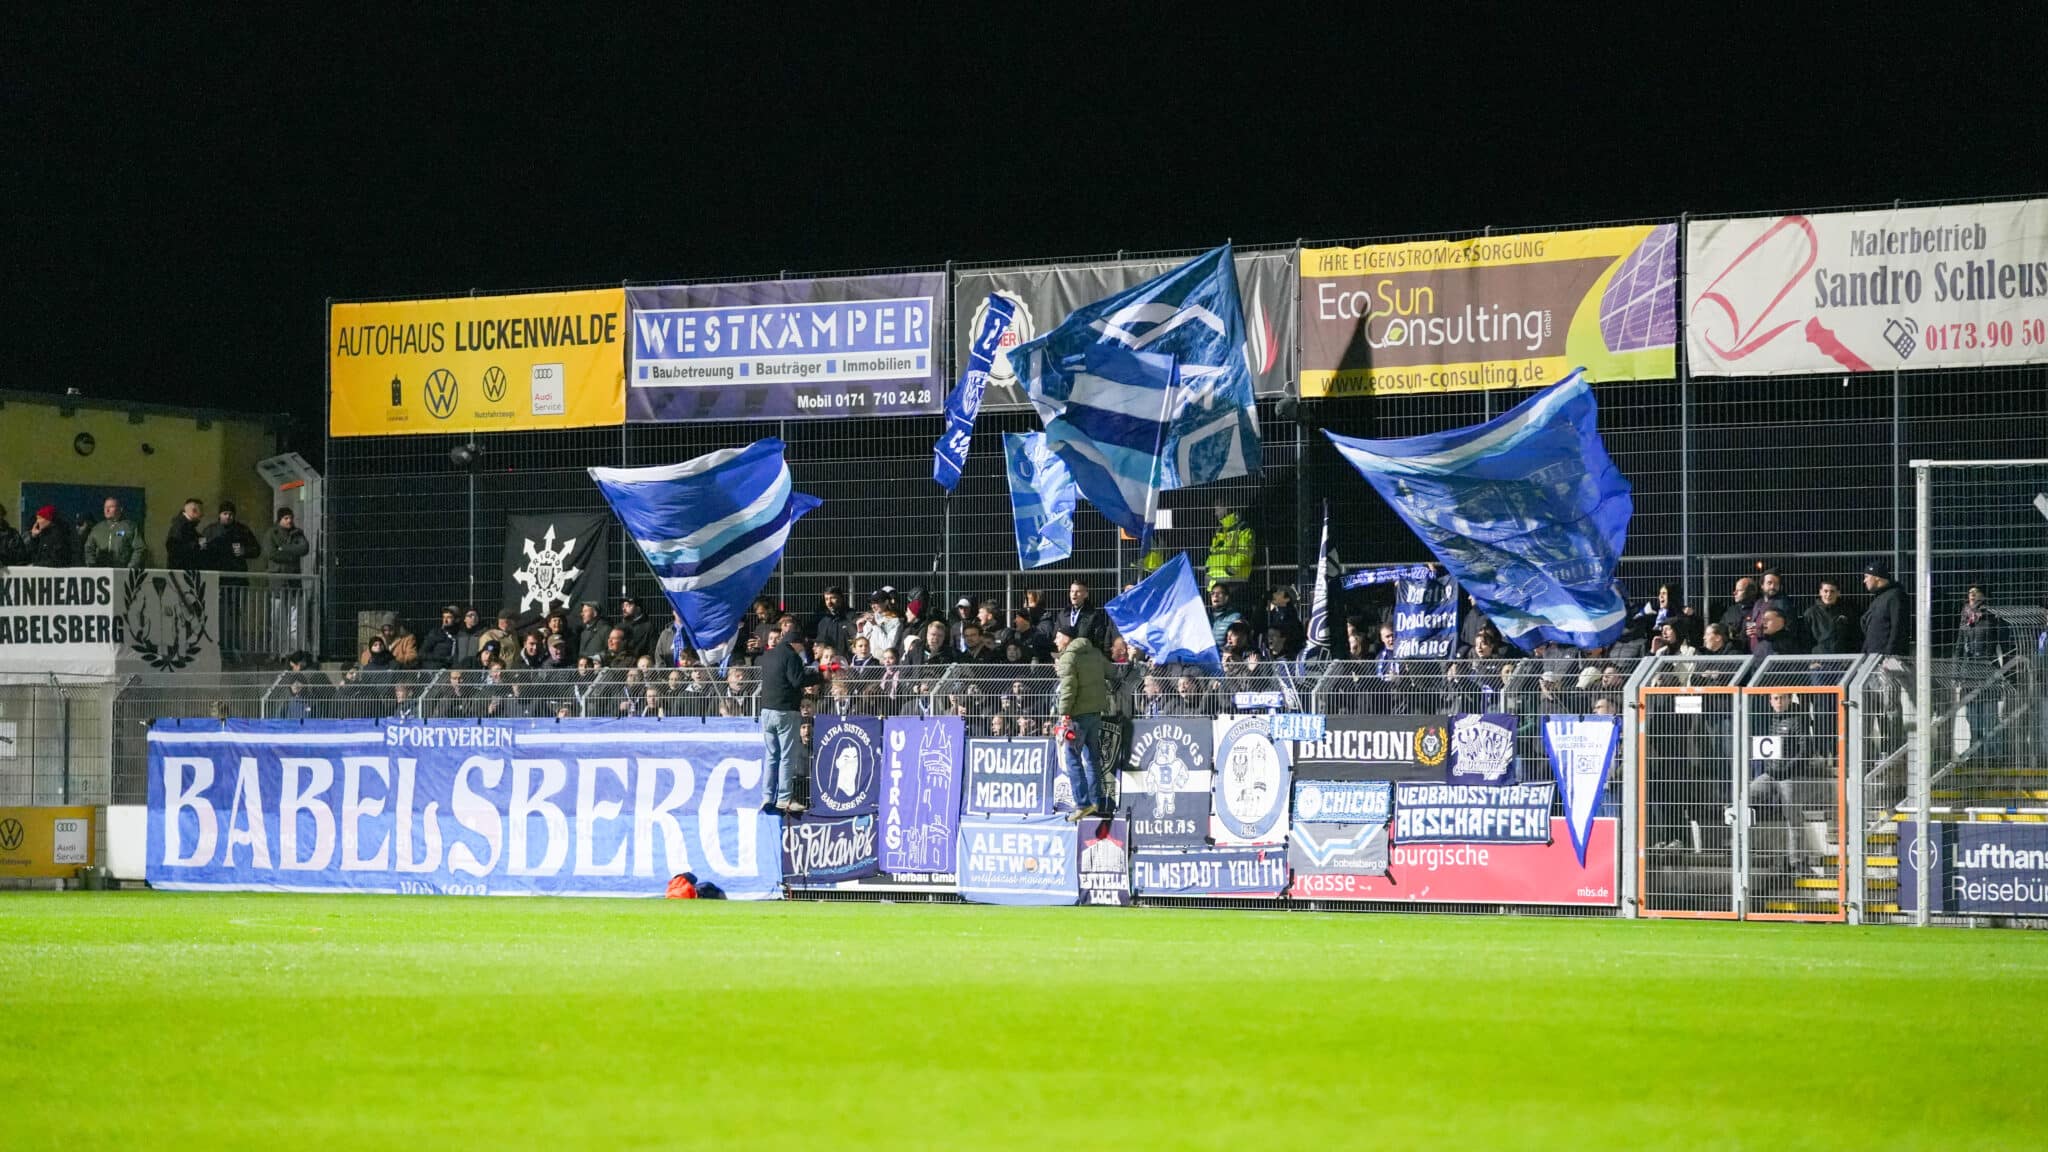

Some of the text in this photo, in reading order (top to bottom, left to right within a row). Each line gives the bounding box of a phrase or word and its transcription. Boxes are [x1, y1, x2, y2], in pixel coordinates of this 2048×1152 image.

[1850, 223, 1987, 257] Malerbetrieb
[1318, 255, 1349, 272] IHRE
[1814, 258, 2048, 308] Sandro Schleus
[1318, 280, 1434, 320] Eco Sun
[337, 312, 618, 357] AUTOHAUS LUCKENWALDE
[638, 306, 924, 353] WESTKÄMPER
[1365, 303, 1544, 350] Consulting
[1925, 318, 2046, 351] 0173.90 50
[652, 358, 912, 380] Baubetreuung Bauträger Immobilien
[1321, 360, 1544, 393] www.ecosun-consulting.de
[797, 389, 931, 409] Mobil 0171 710 24 28
[0, 576, 111, 606] KINHEADS
[0, 614, 125, 645] ABELSBERG
[387, 726, 513, 747] SPORTVEREIN
[1299, 731, 1415, 761] BRICCONI
[1760, 738, 1774, 758] C
[973, 748, 1043, 774] POLIZIA
[885, 730, 906, 850] ULTRAS
[975, 782, 1038, 809] MERDA
[1398, 785, 1548, 806] VERBANDSSTRAFEN
[162, 756, 763, 878] BABELSBERG
[1135, 819, 1197, 836] ULTRAS
[1399, 808, 1547, 837] ABSCHAFFEN!
[972, 833, 1066, 857] ALERTA
[1391, 845, 1489, 871] burgische
[1952, 842, 2048, 869] Lufthan
[1134, 858, 1284, 888] FILMSTADT YOUTH
[1292, 874, 1356, 893] rkasse
[1577, 887, 1609, 898] mbs.de
